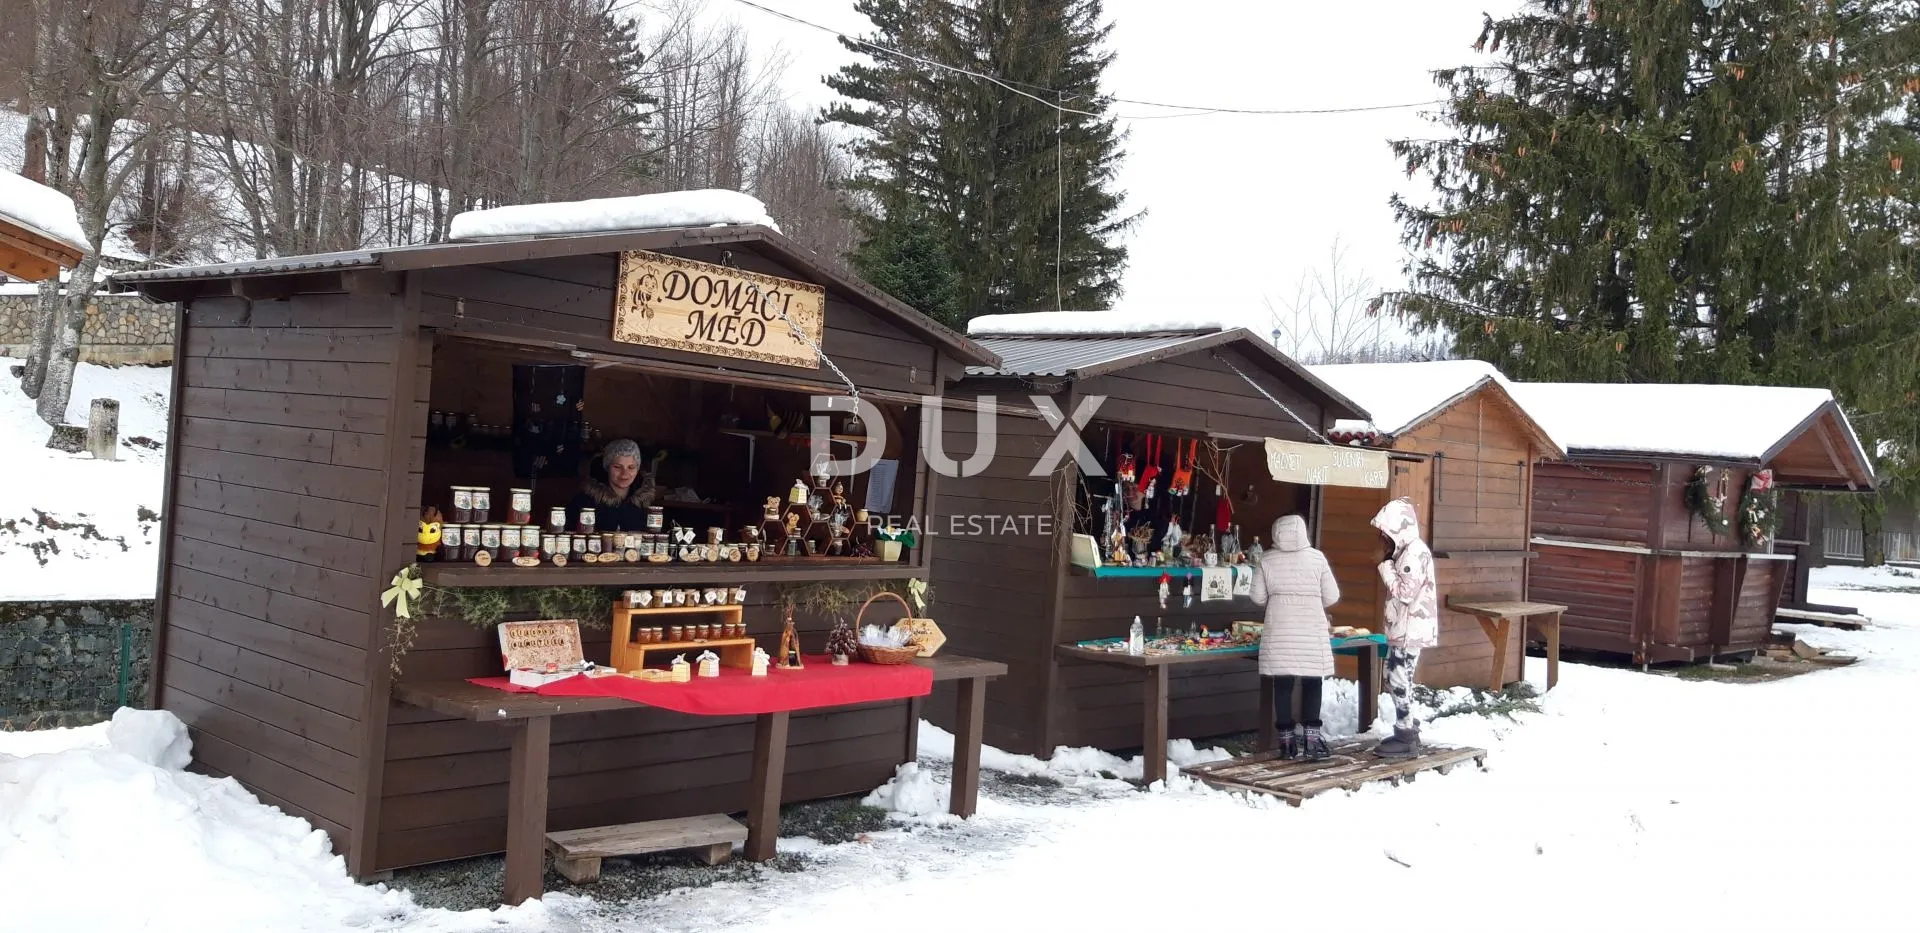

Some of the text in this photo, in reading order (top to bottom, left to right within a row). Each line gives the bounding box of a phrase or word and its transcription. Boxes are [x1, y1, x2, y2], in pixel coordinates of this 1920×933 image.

[662, 270, 794, 322] DOMAĆI
[685, 310, 766, 348] MED
[1306, 466, 1329, 485] NAKIT
